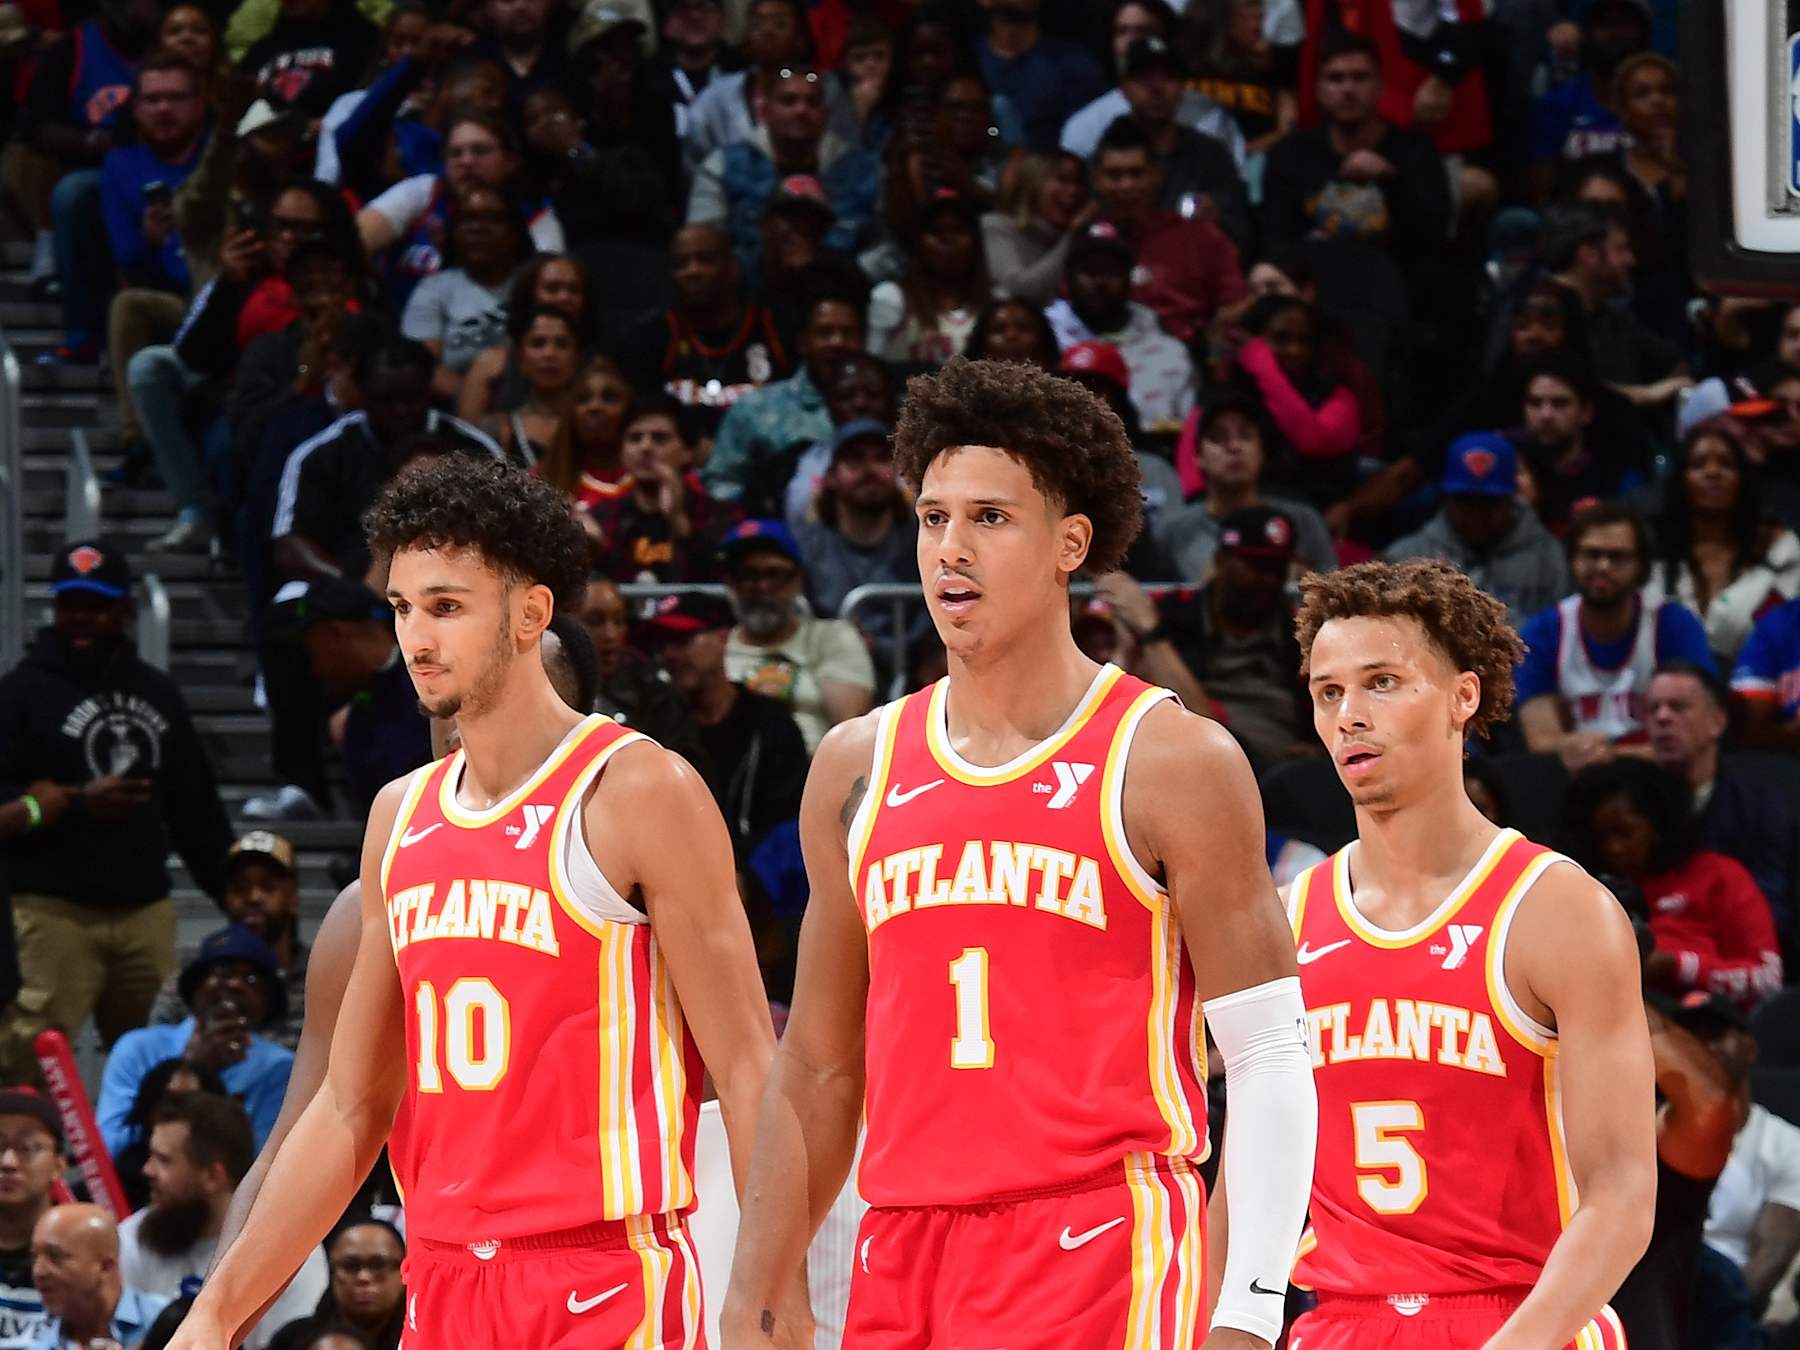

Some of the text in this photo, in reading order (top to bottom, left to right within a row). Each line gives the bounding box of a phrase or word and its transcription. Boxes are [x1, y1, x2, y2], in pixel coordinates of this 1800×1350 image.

[1032, 781, 1053, 794] the
[866, 840, 1107, 931] ATLANTA
[416, 977, 511, 1093] 10
[950, 947, 995, 1069] 1
[1306, 999, 1507, 1078] TLANTA
[1350, 1100, 1429, 1215] 5
